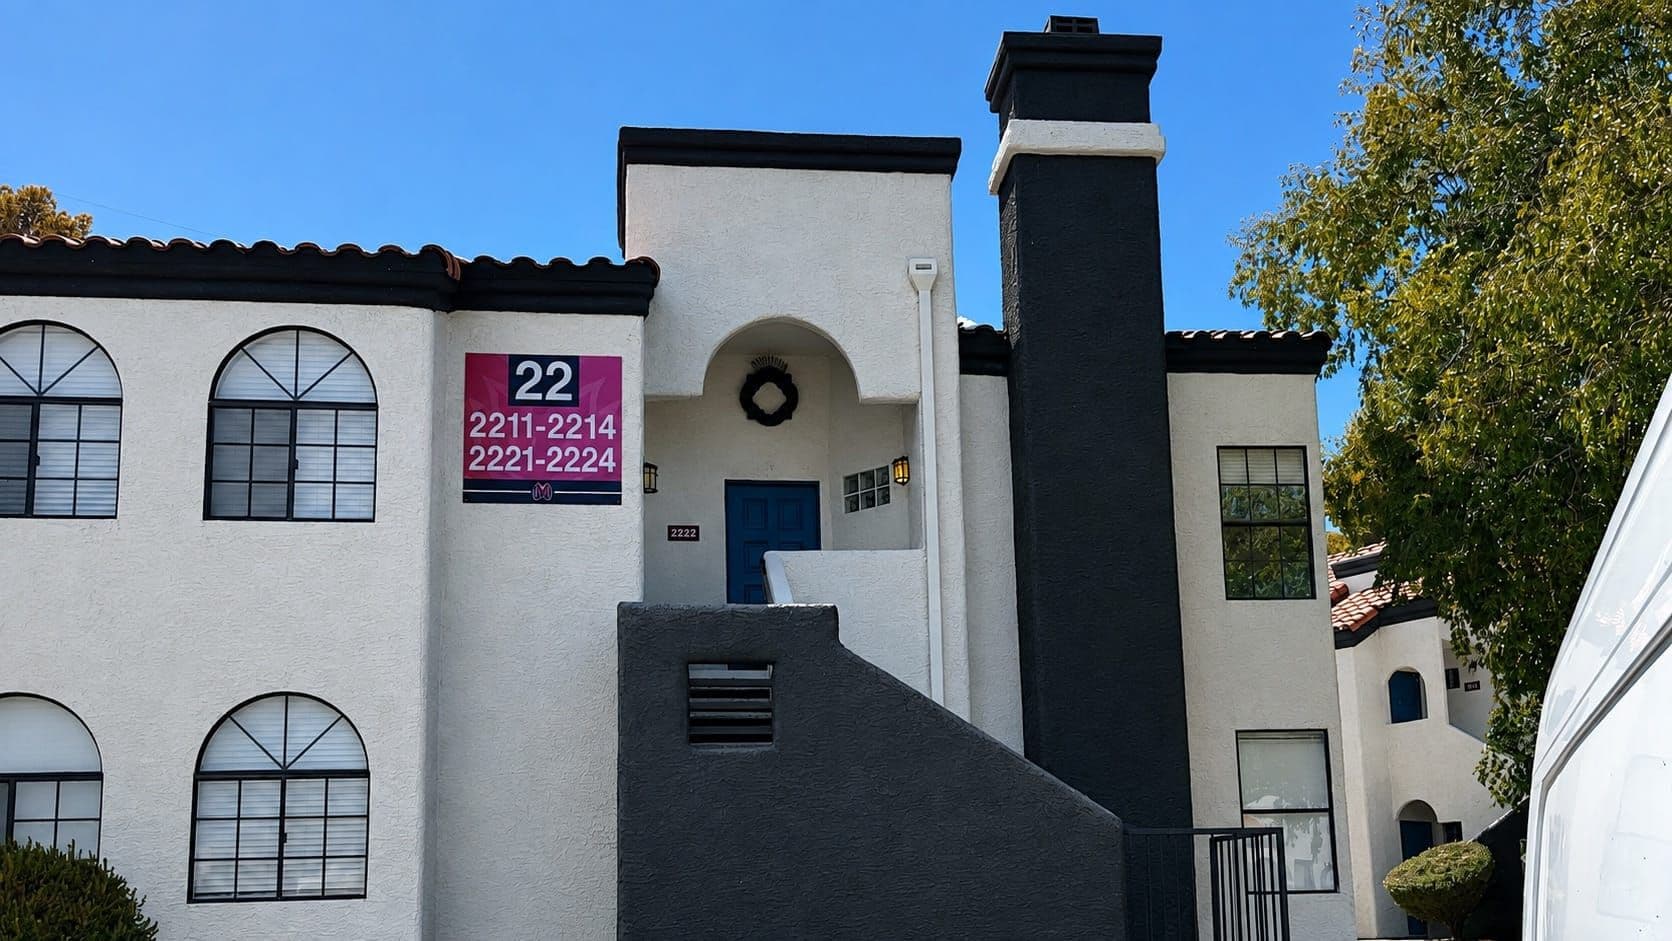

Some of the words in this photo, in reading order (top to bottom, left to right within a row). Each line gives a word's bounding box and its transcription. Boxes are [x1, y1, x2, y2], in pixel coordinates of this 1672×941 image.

[515, 360, 573, 401] 22
[469, 411, 616, 440] 2211-2214
[468, 445, 616, 473] 2221-2224
[671, 528, 697, 538] 2222
